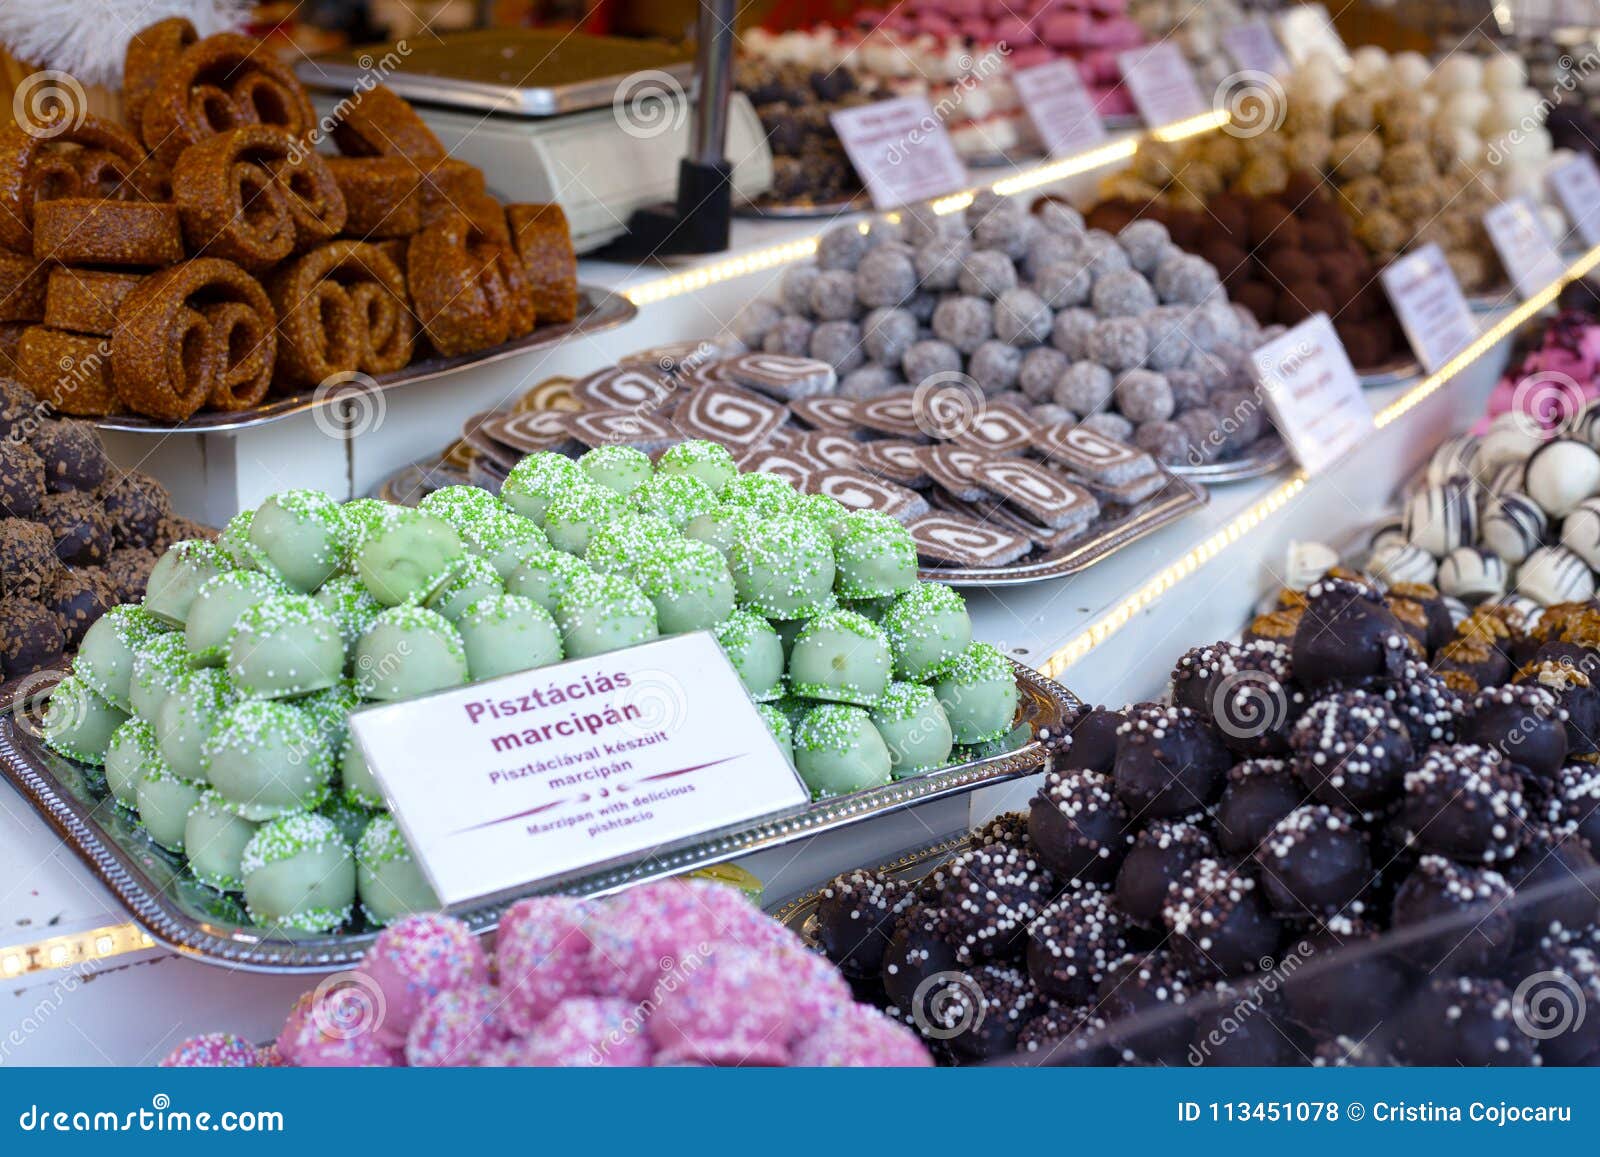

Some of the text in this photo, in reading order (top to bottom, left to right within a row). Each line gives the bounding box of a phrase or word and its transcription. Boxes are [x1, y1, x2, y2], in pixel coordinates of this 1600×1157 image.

[464, 671, 632, 724] Pisztáciás
[491, 703, 641, 752] marcipán
[489, 747, 601, 785] Pisztáciával
[548, 759, 633, 790] marcipán
[526, 783, 696, 835] Marzipan with delicious
[588, 811, 654, 838] pishtacio
